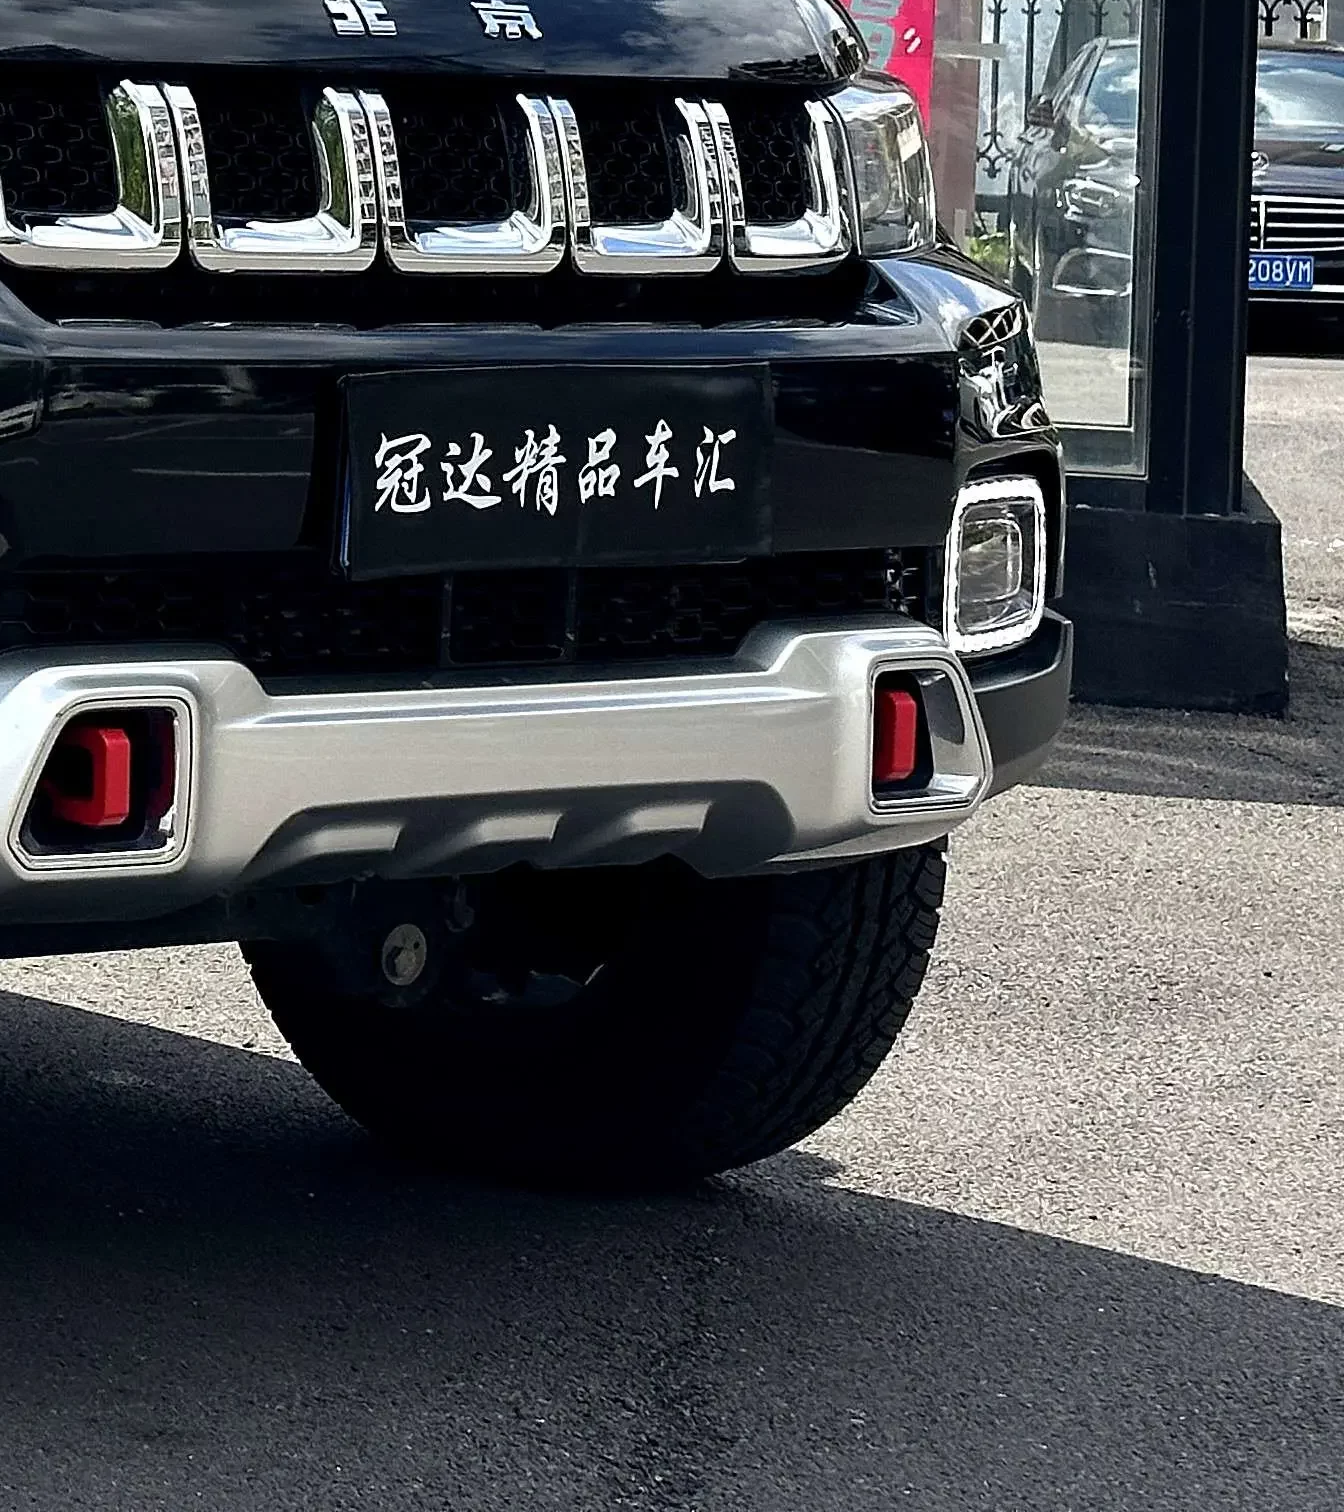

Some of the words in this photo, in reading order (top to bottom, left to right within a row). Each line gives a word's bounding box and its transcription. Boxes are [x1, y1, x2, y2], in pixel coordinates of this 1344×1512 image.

[373, 417, 738, 517] 冠达精品车汇
